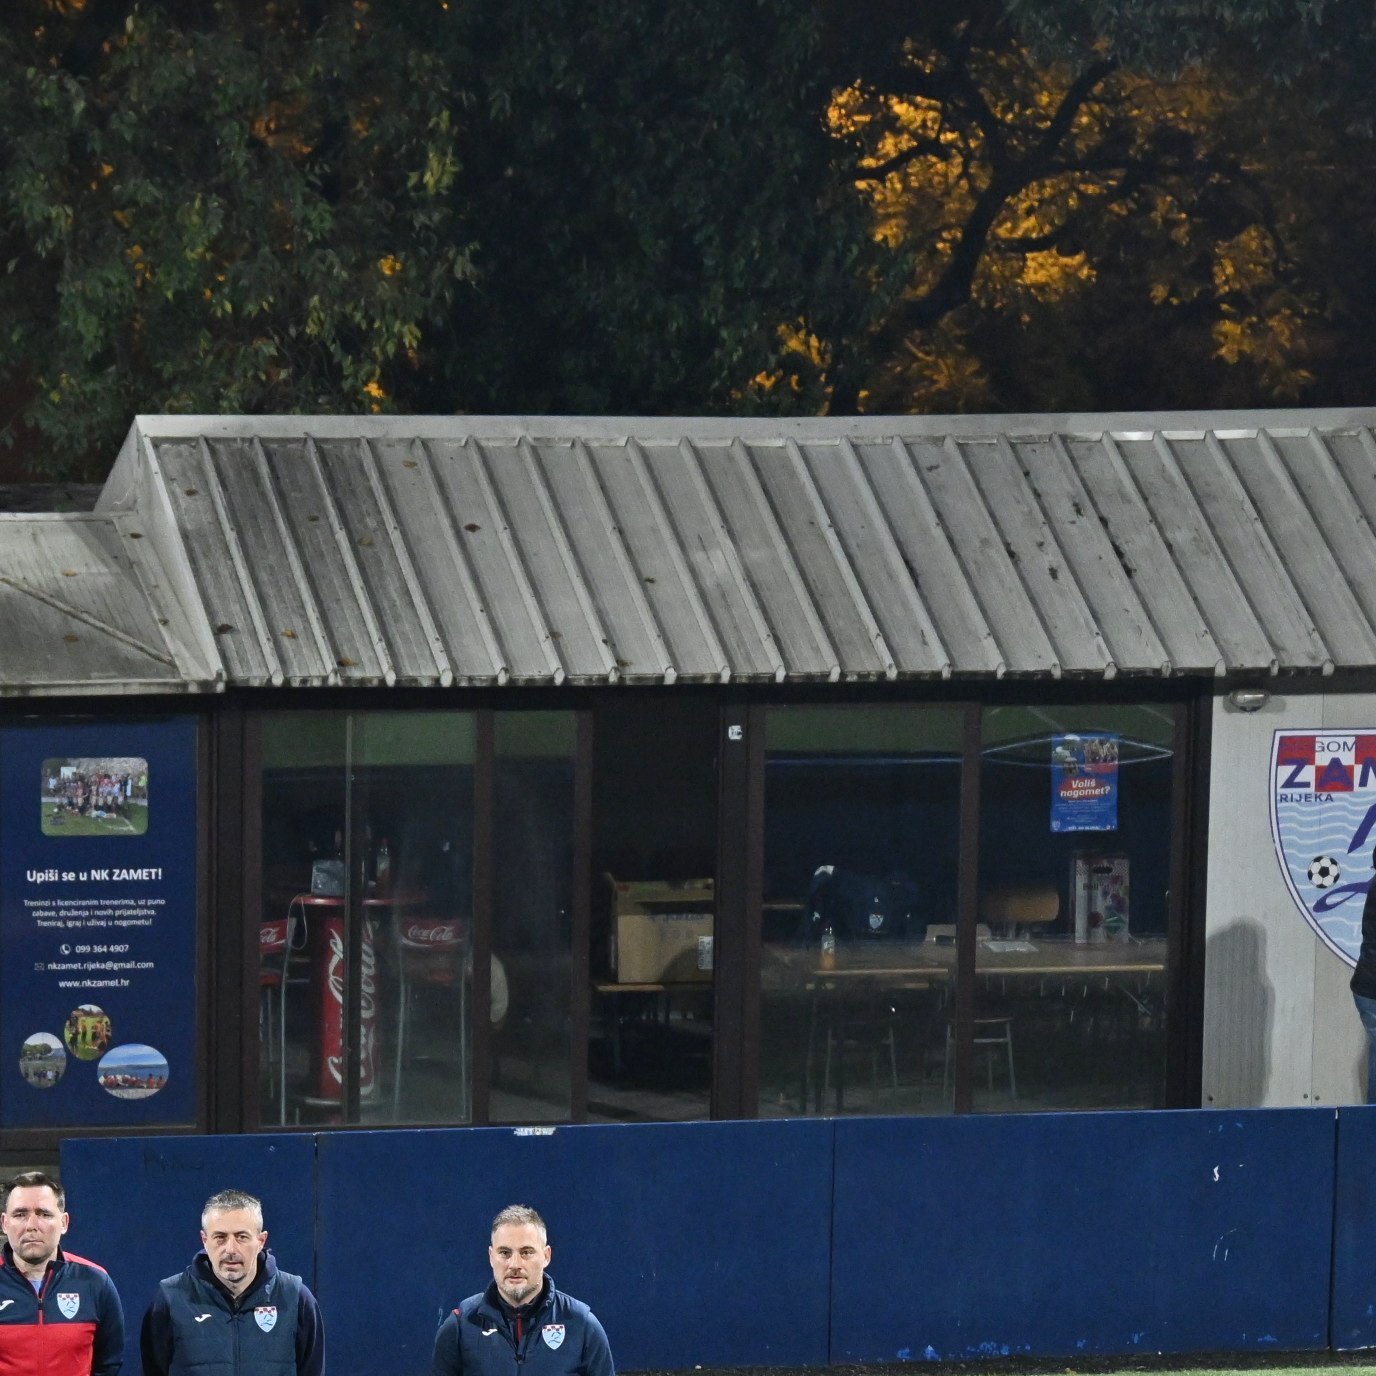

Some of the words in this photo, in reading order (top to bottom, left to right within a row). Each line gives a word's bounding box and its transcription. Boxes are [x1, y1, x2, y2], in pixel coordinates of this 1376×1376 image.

[1280, 792, 1335, 803] RIJEKA
[26, 869, 59, 884] Upiši
[61, 871, 76, 882] se
[79, 871, 88, 882] u
[90, 869, 110, 881] NK
[112, 868, 163, 881] ZAMET!
[75, 945, 91, 954] 099
[93, 945, 107, 954] 364
[109, 944, 129, 953] 4907
[48, 960, 154, 972] nkzamet.rijeka@gmail.com
[58, 978, 130, 988] www.nkzamet.hr
